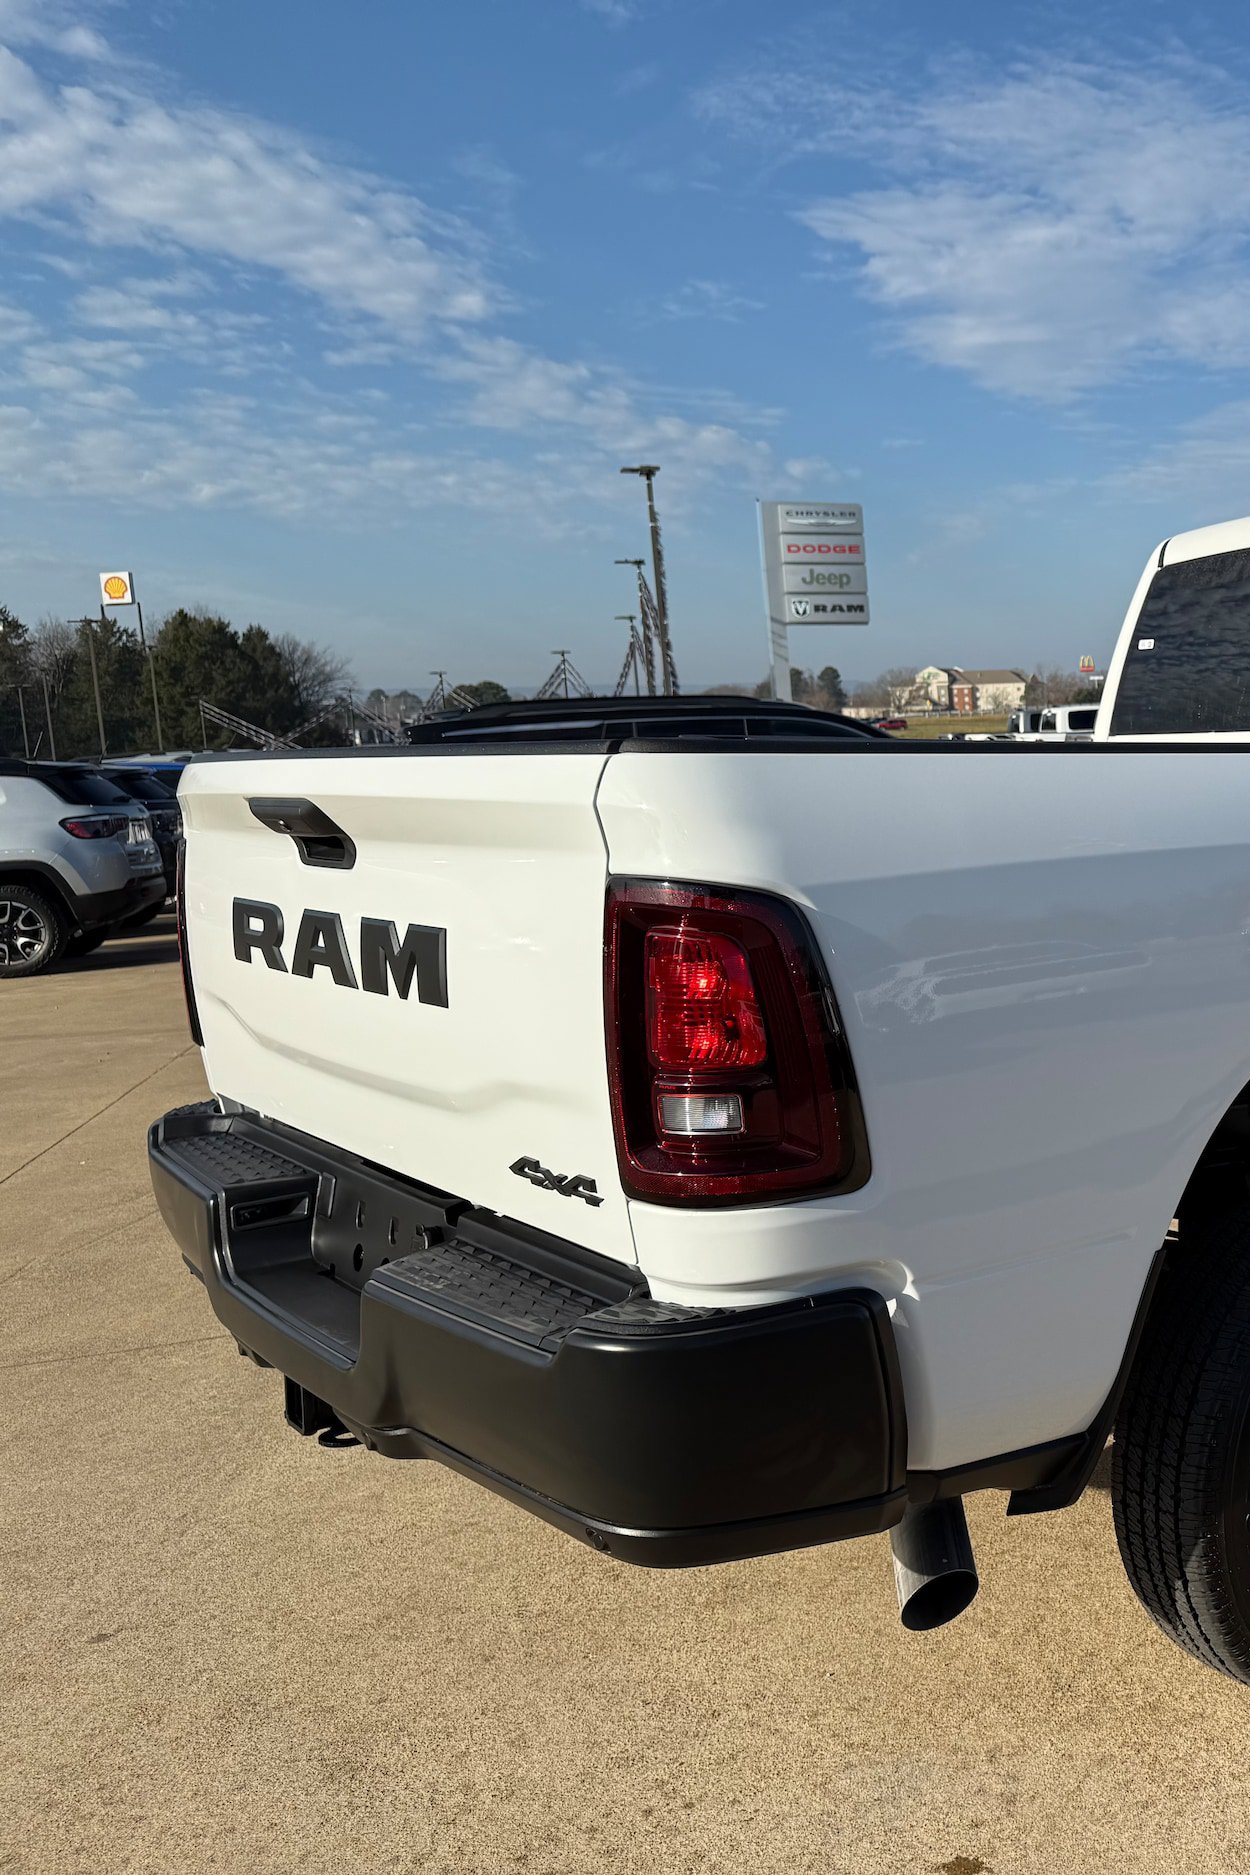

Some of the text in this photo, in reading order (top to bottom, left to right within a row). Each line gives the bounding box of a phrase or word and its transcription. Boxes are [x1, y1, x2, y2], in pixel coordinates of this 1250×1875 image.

[785, 509, 857, 518] CHRYSLER
[786, 544, 861, 554] DODGE
[802, 568, 851, 589] Jeep
[813, 603, 865, 613] RAM
[232, 896, 449, 1009] RAM
